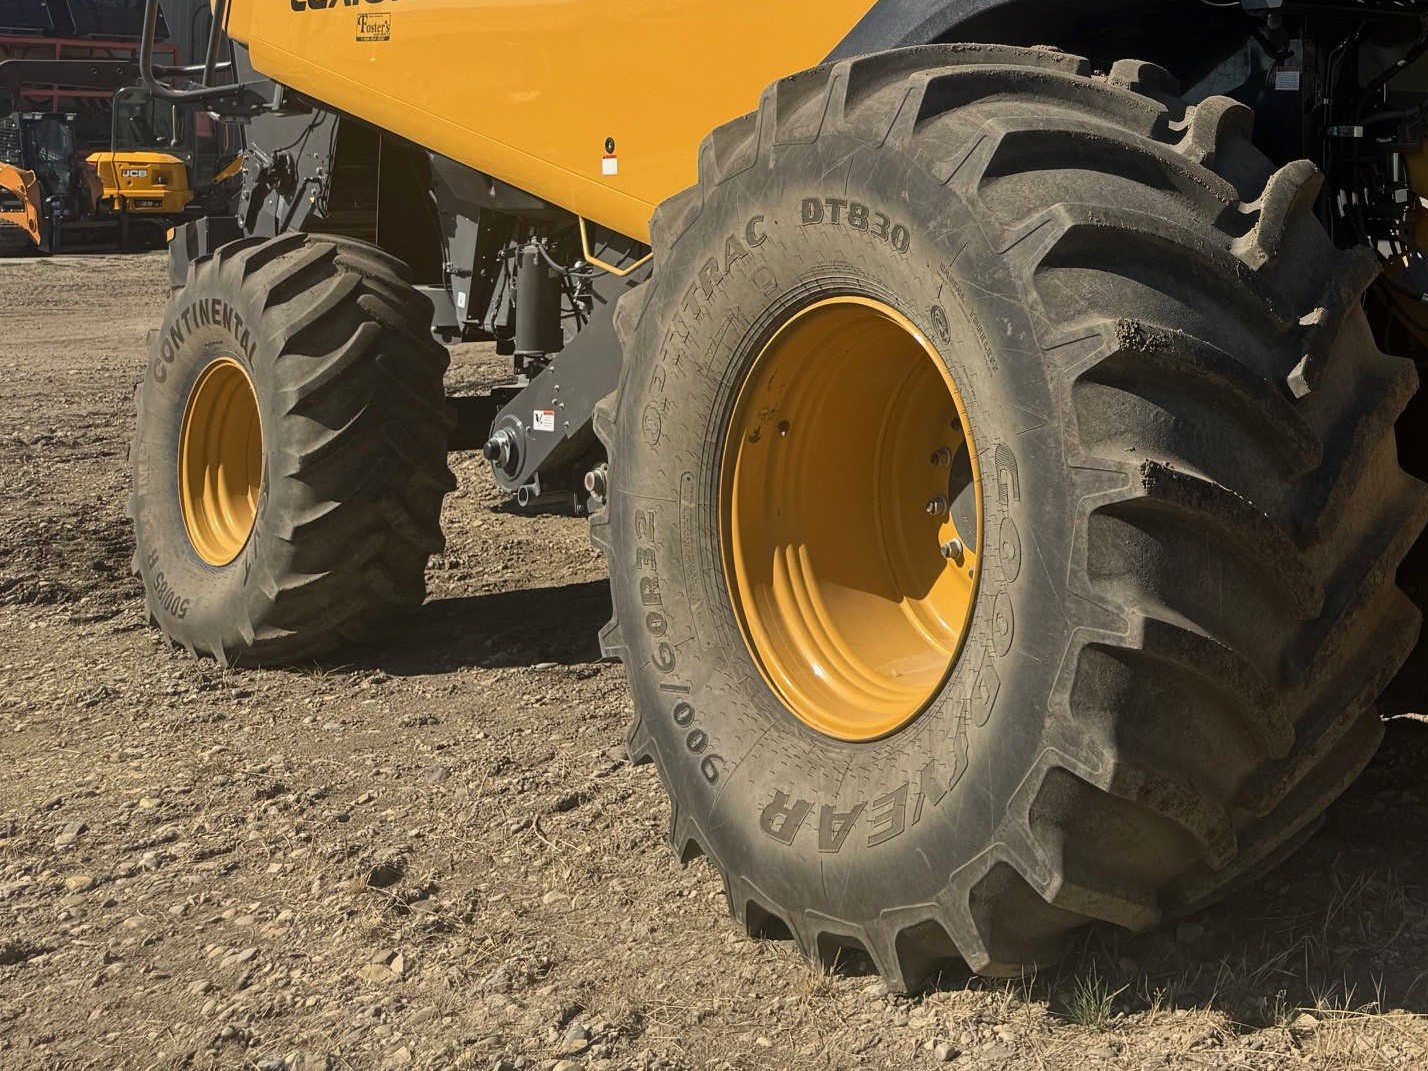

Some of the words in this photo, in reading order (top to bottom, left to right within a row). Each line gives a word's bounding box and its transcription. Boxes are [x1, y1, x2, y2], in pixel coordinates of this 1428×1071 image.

[122, 169, 148, 178] JCB
[801, 197, 912, 254] DT830
[152, 297, 258, 385] CONTINENTAL
[153, 570, 191, 620] 500/85
[634, 508, 728, 786] 900/60R32
